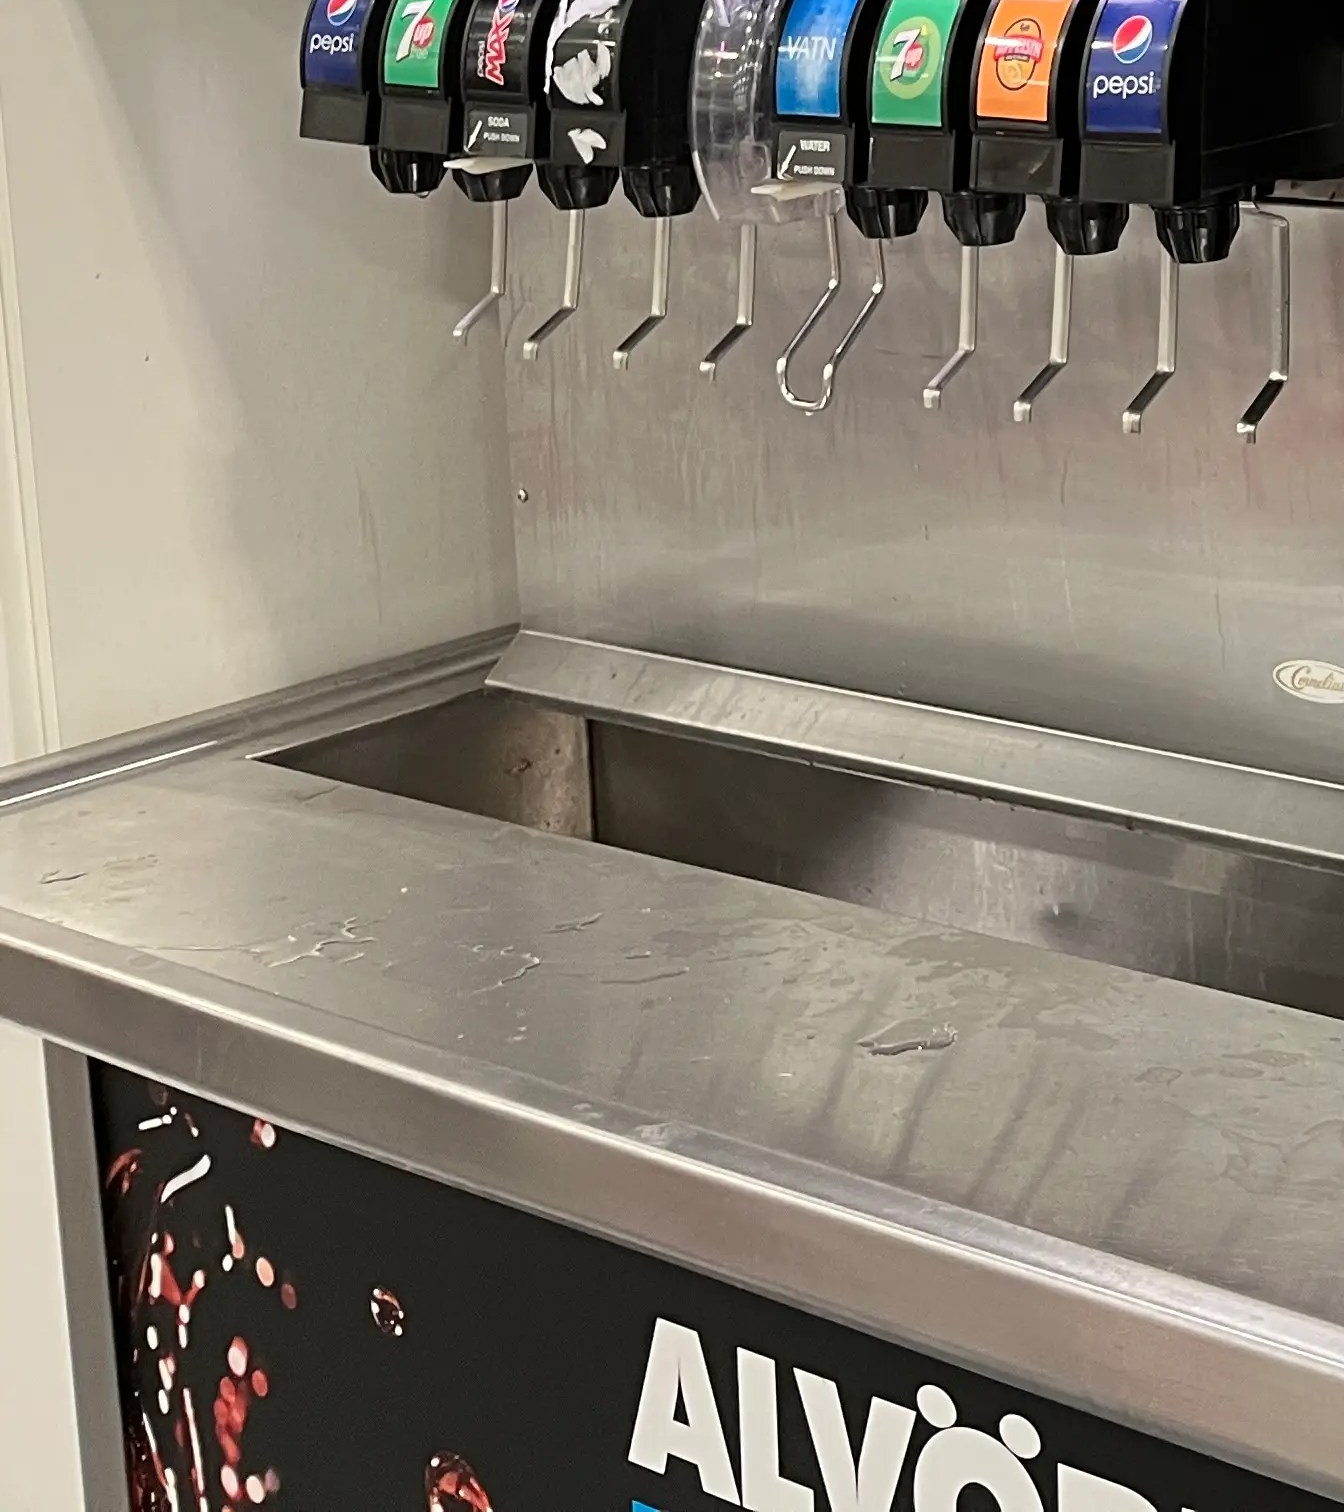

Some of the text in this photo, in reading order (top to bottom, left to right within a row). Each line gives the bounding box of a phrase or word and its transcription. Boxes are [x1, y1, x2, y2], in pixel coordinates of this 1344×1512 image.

[310, 32, 354, 55] pepsi
[485, 8, 515, 86] MAX
[786, 35, 837, 62] VATN
[1093, 72, 1155, 99] pepsi
[799, 139, 831, 153] WATER
[628, 1317, 1192, 1512] ALVÖ
